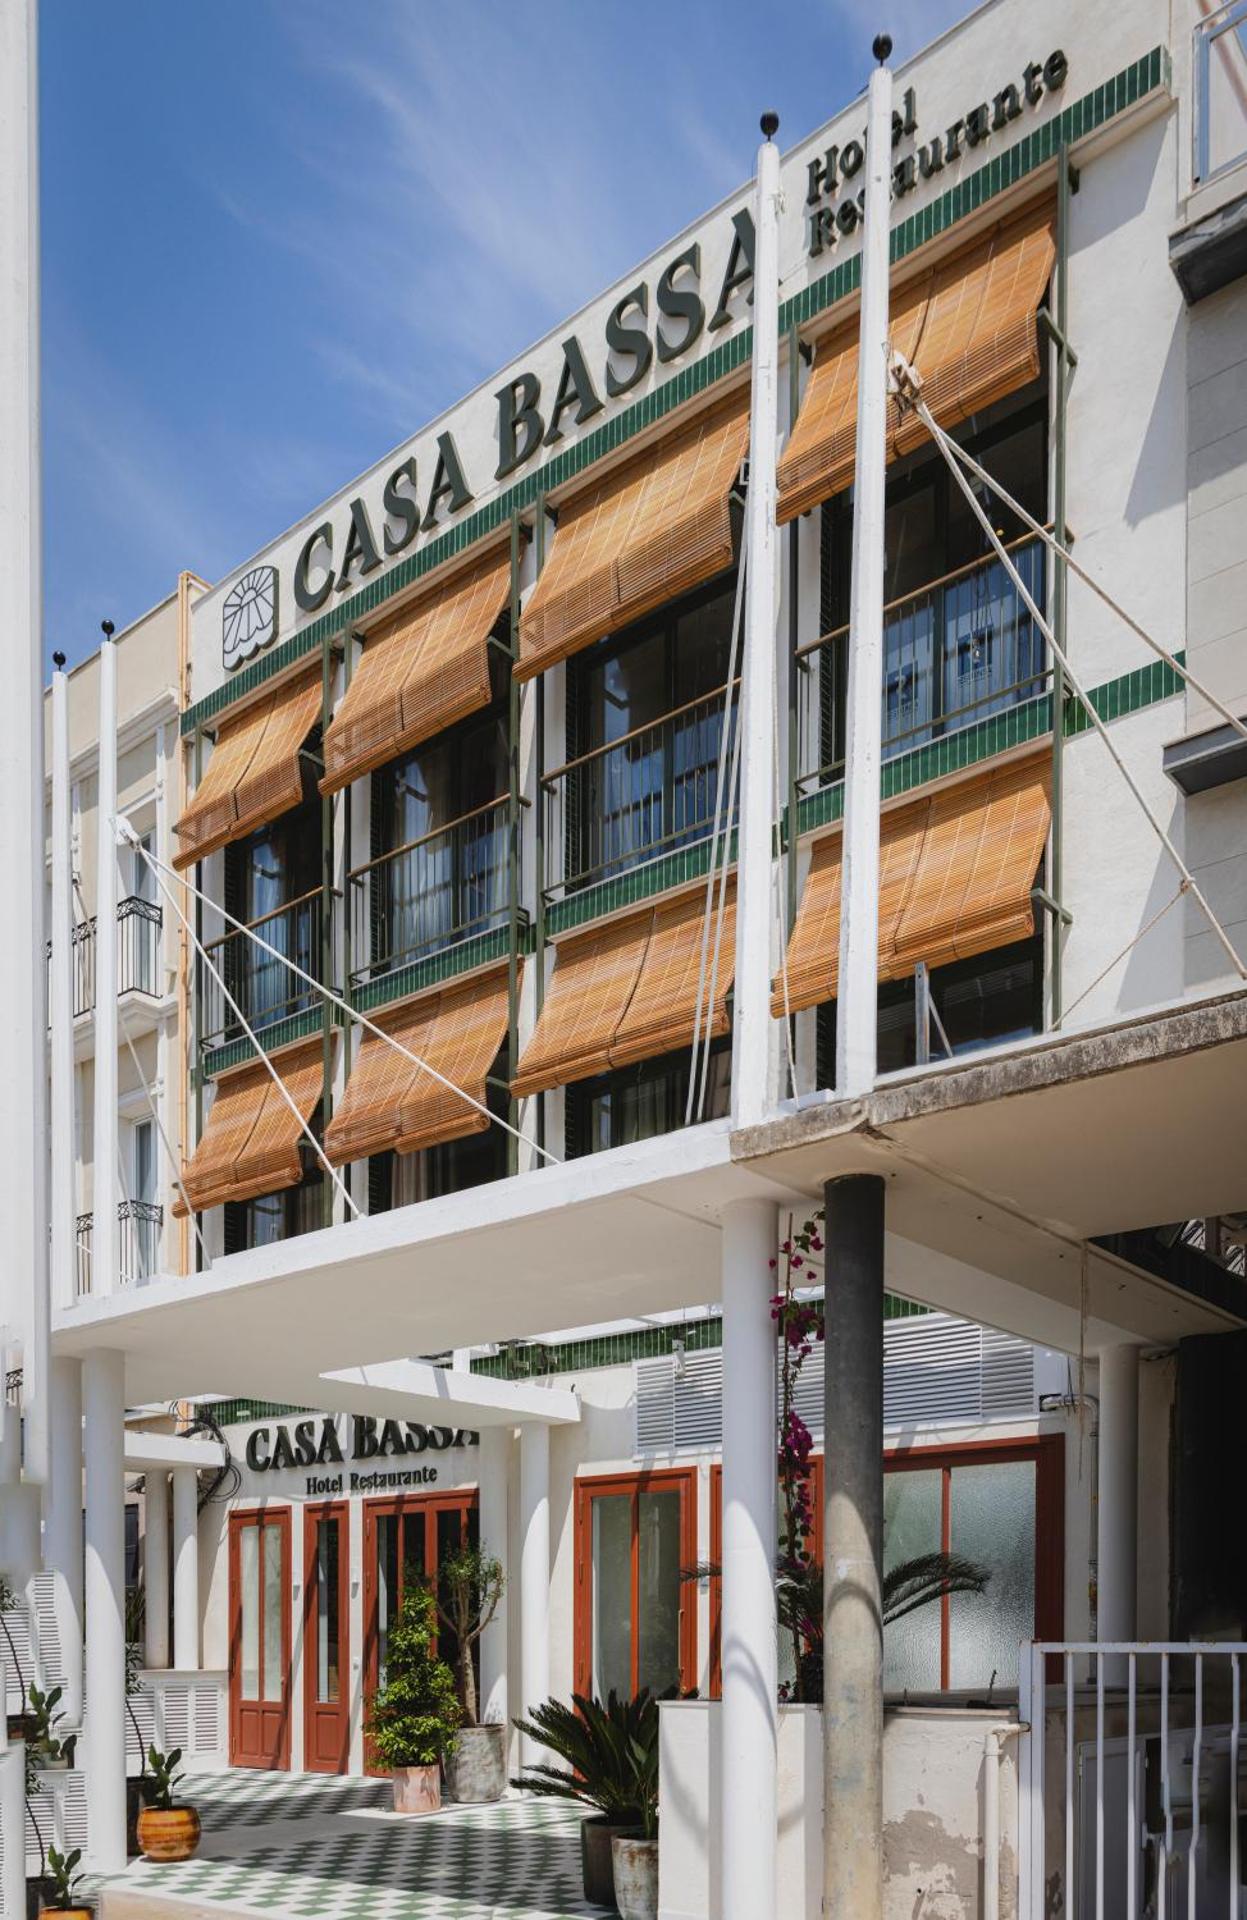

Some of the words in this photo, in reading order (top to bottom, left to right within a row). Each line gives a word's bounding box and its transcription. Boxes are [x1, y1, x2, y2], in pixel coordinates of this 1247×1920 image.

[808, 49, 1068, 258] Reaurante
[294, 430, 475, 612] CASA
[493, 206, 756, 481] BASSA
[246, 1418, 344, 1472] CASA
[306, 1474, 343, 1495] Hotel
[350, 1466, 437, 1490] Restaurante
